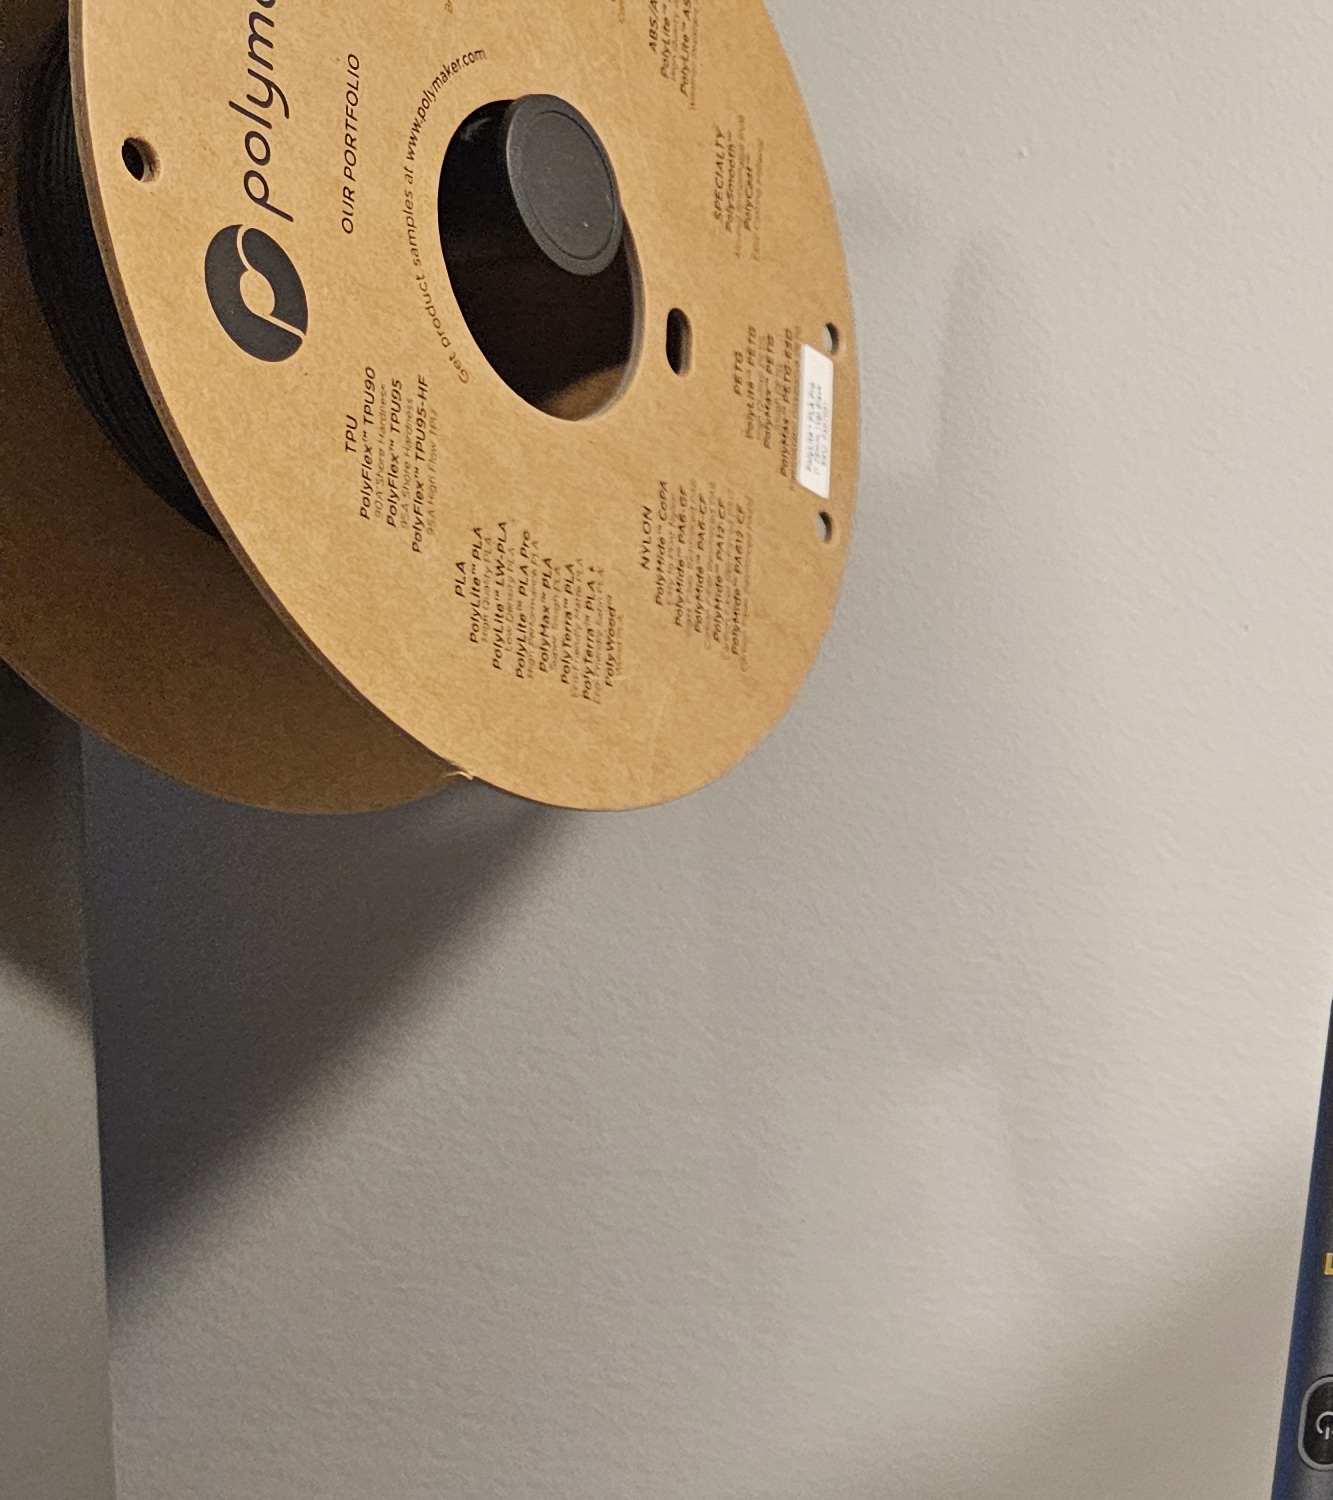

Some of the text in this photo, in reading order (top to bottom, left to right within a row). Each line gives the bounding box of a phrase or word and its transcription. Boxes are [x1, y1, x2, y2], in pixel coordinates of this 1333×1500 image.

[228, 0, 294, 222] polym
[341, 53, 360, 235] OUR PORTFOLIO
[714, 121, 726, 222] SPECIALTY
[402, 49, 487, 384] Get product samples at www.polymaker.com
[363, 365, 376, 426] TPU90
[733, 350, 744, 397] PETG
[391, 377, 403, 434] TPU95
[415, 374, 428, 462] TPU95-HF
[345, 414, 358, 454] TPU
[472, 527, 483, 561] PLA
[495, 522, 508, 587] LW-PLA
[520, 528, 531, 559] Pro
[639, 505, 653, 571] NYLON
[455, 561, 467, 598] PLA
[518, 565, 529, 597] PLA
[542, 557, 553, 589] PLA
[564, 564, 575, 595] PLA
[586, 580, 596, 611] PLA
